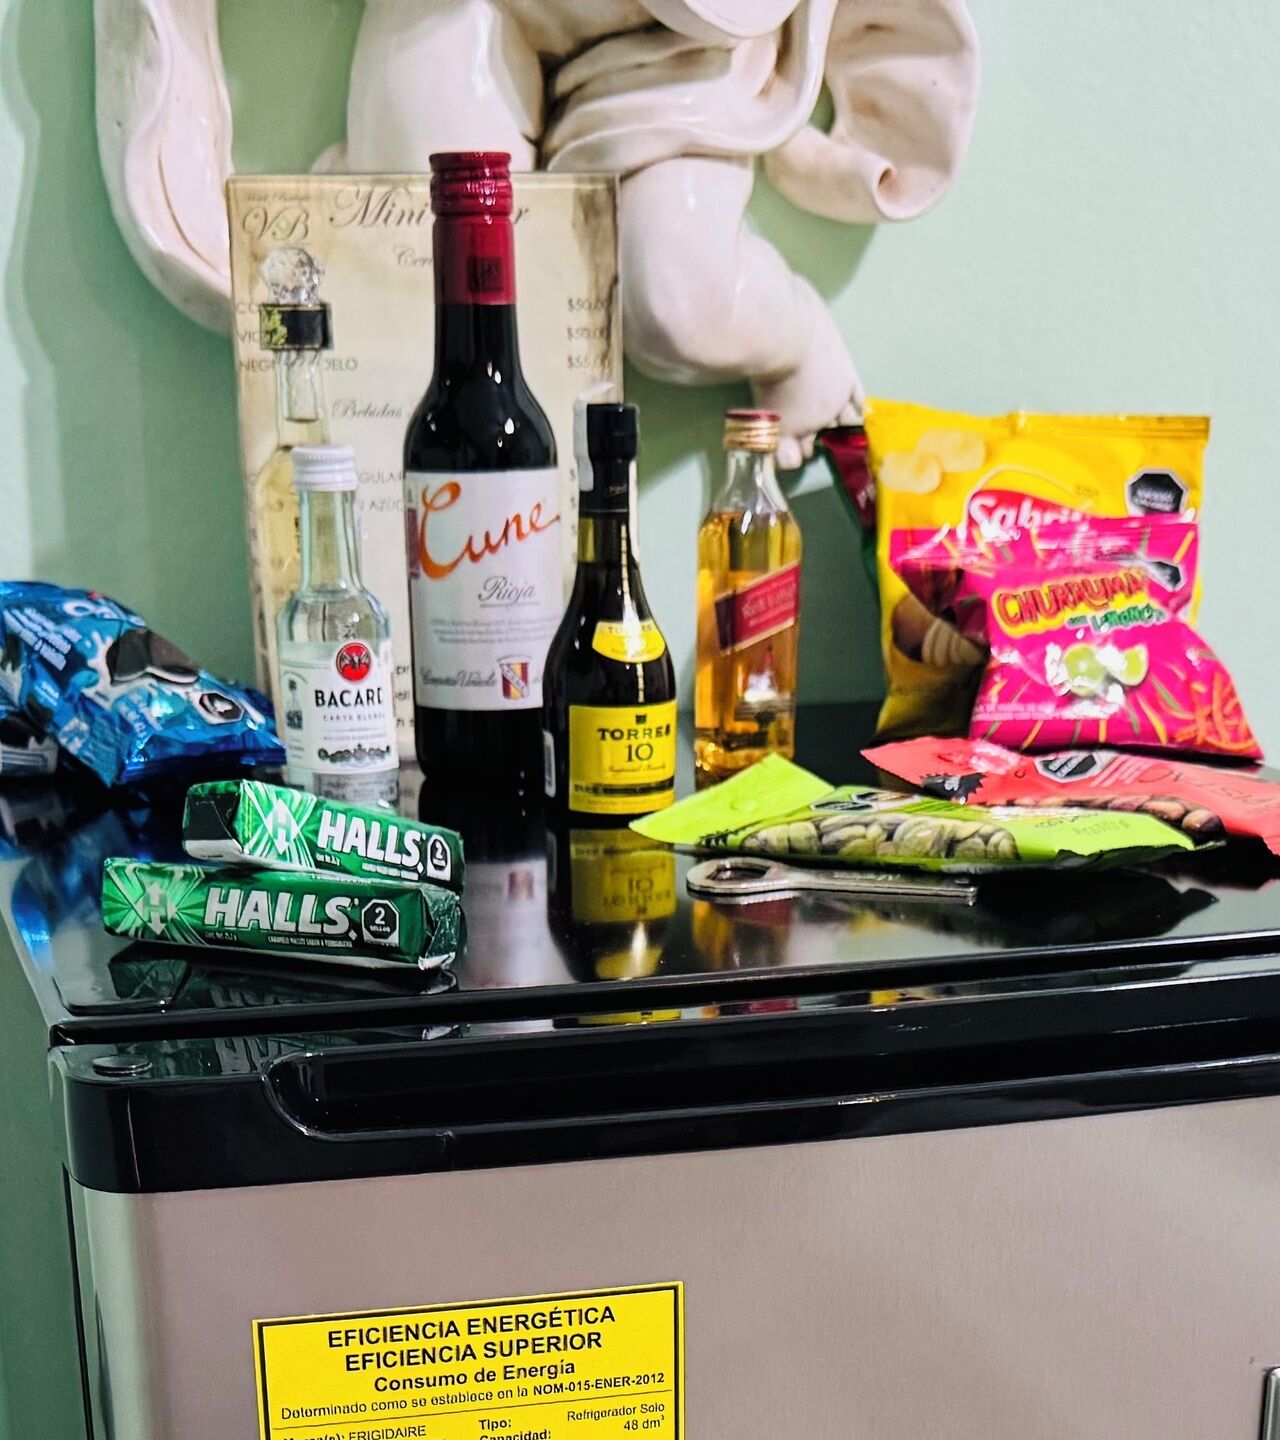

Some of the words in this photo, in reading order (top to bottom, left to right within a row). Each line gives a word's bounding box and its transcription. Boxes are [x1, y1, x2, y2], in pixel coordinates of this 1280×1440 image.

[419, 480, 561, 581] Cune
[478, 575, 536, 602] Rioja
[626, 742, 654, 763] 10
[316, 809, 422, 868] HALLS
[203, 886, 351, 936] HALLS
[374, 906, 387, 926] 2
[328, 1321, 460, 1348] EFICIENCIA
[467, 1306, 615, 1335] ENERGÉTICA
[346, 1344, 477, 1371] EFICIENCIA
[484, 1332, 602, 1358] SUPERIOR
[375, 1373, 467, 1392] Consumo
[474, 1367, 496, 1383] de
[504, 1359, 575, 1380] Energía
[282, 1402, 367, 1420] Determinado
[371, 1399, 407, 1411] como
[412, 1397, 426, 1408] se
[431, 1389, 493, 1405] establece
[497, 1388, 513, 1400] en
[518, 1385, 528, 1398] la
[534, 1372, 664, 1395] NOM-015-ENER-2012
[567, 1405, 636, 1421] Refrigerador
[640, 1402, 665, 1413] Solo
[479, 1419, 512, 1431] Tipo:
[624, 1419, 638, 1431] 48
